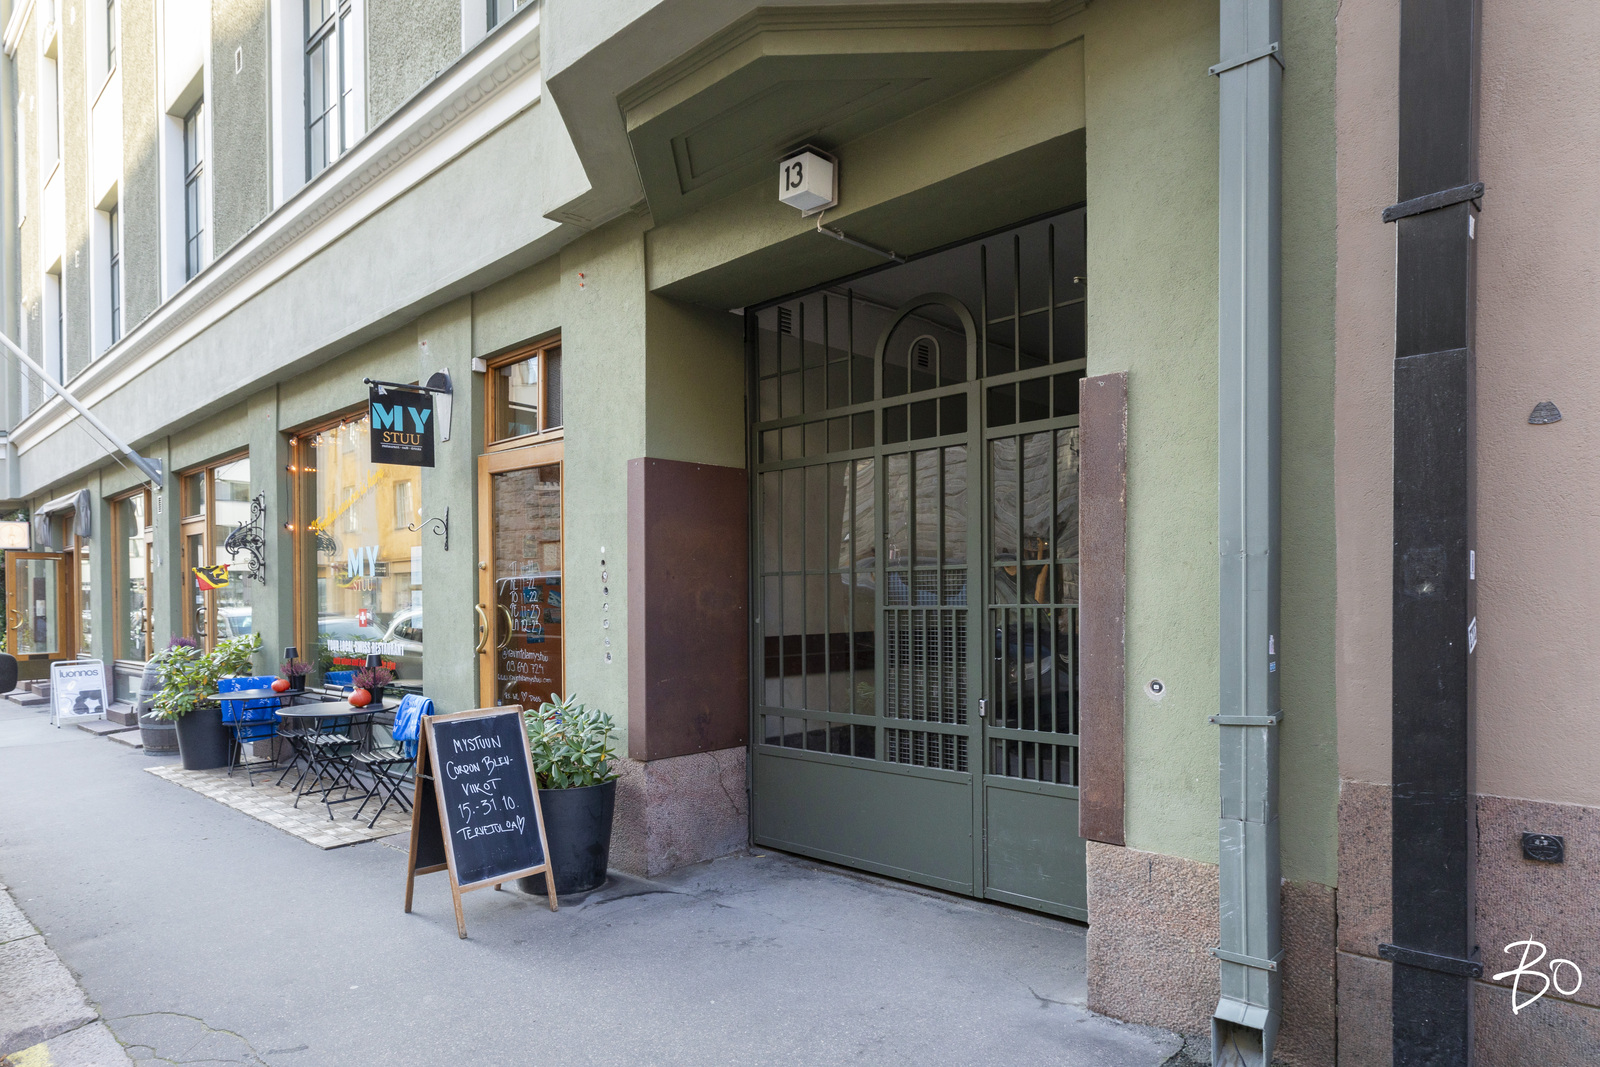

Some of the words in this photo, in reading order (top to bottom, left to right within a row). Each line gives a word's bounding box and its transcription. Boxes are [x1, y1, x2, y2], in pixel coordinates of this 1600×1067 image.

[784, 161, 803, 192] 13
[372, 402, 432, 434] MY
[383, 431, 420, 446] STUU
[348, 545, 379, 578] MY
[352, 578, 373, 592] STUU
[340, 640, 354, 652] LOCAL
[354, 641, 371, 654] SWISS
[372, 642, 404, 656] RESTAURANT
[60, 670, 98, 678] luonnos
[506, 660, 516, 672] 09
[517, 662, 528, 674] 640
[453, 735, 502, 754] MYSTUUN
[462, 778, 502, 796] VIIKOT
[456, 820, 518, 841] TERVETULOA
